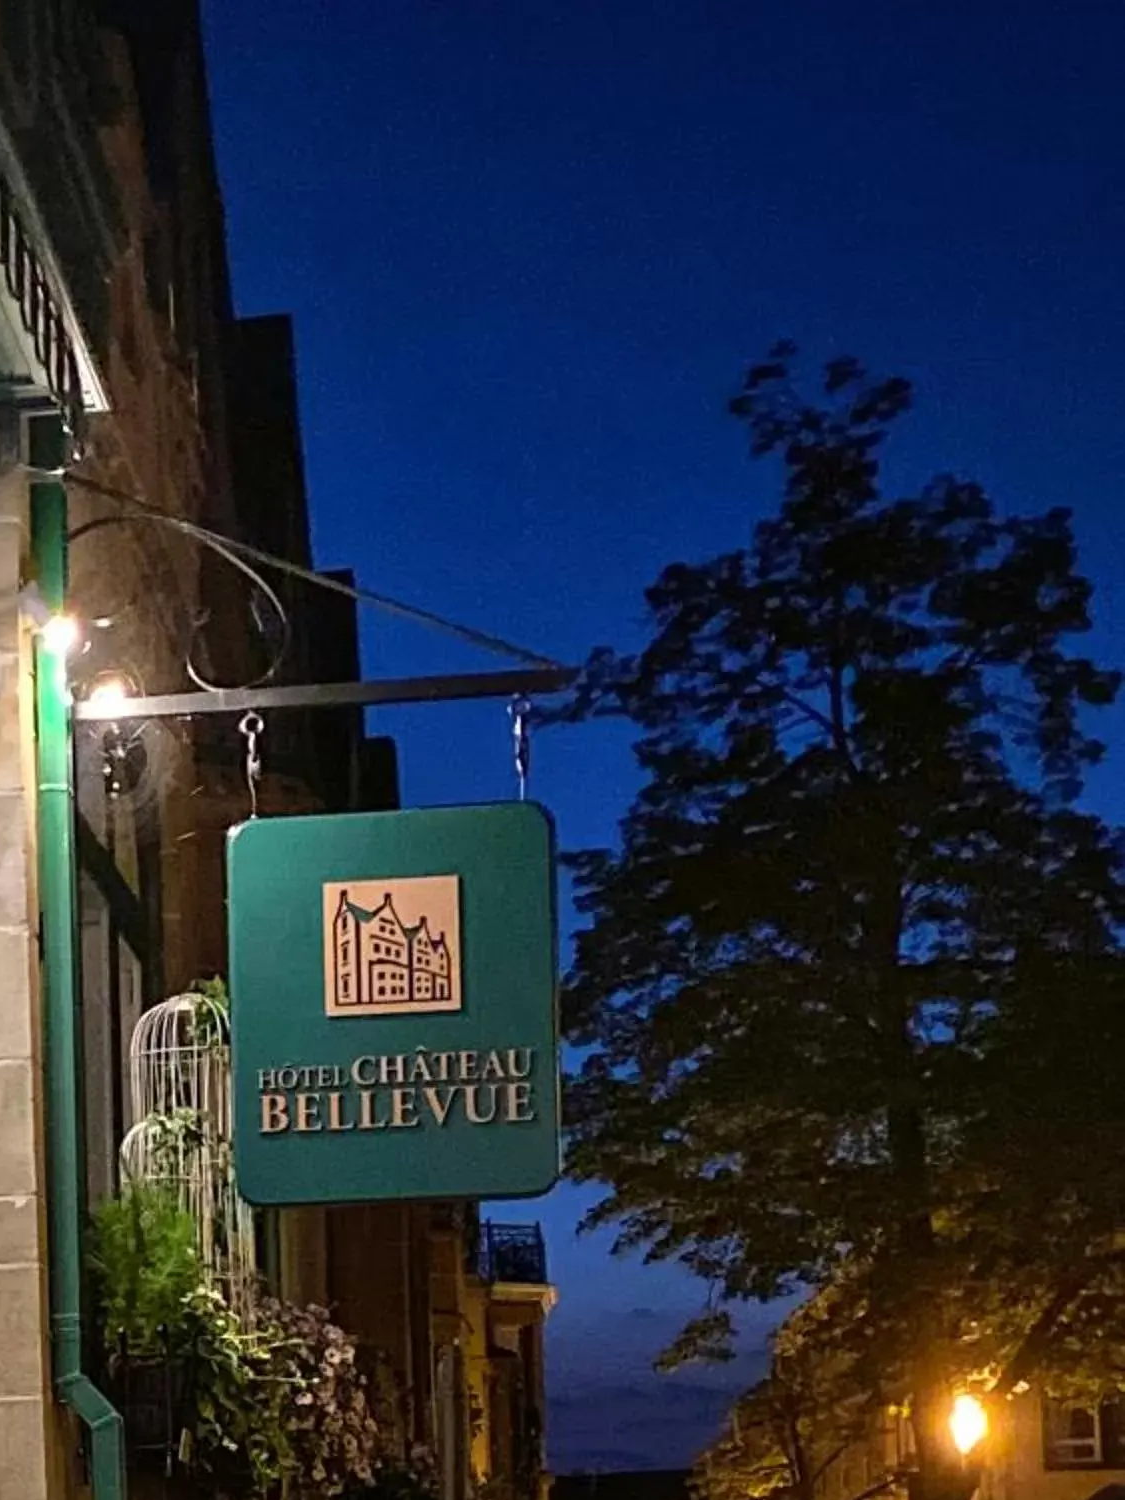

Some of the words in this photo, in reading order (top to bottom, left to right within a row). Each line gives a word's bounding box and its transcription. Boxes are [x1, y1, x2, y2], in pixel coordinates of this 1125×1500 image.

[258, 1063, 348, 1090] HÔTEL
[352, 1046, 533, 1084] CHÂTEAU
[260, 1084, 535, 1133] BELLEVUE
